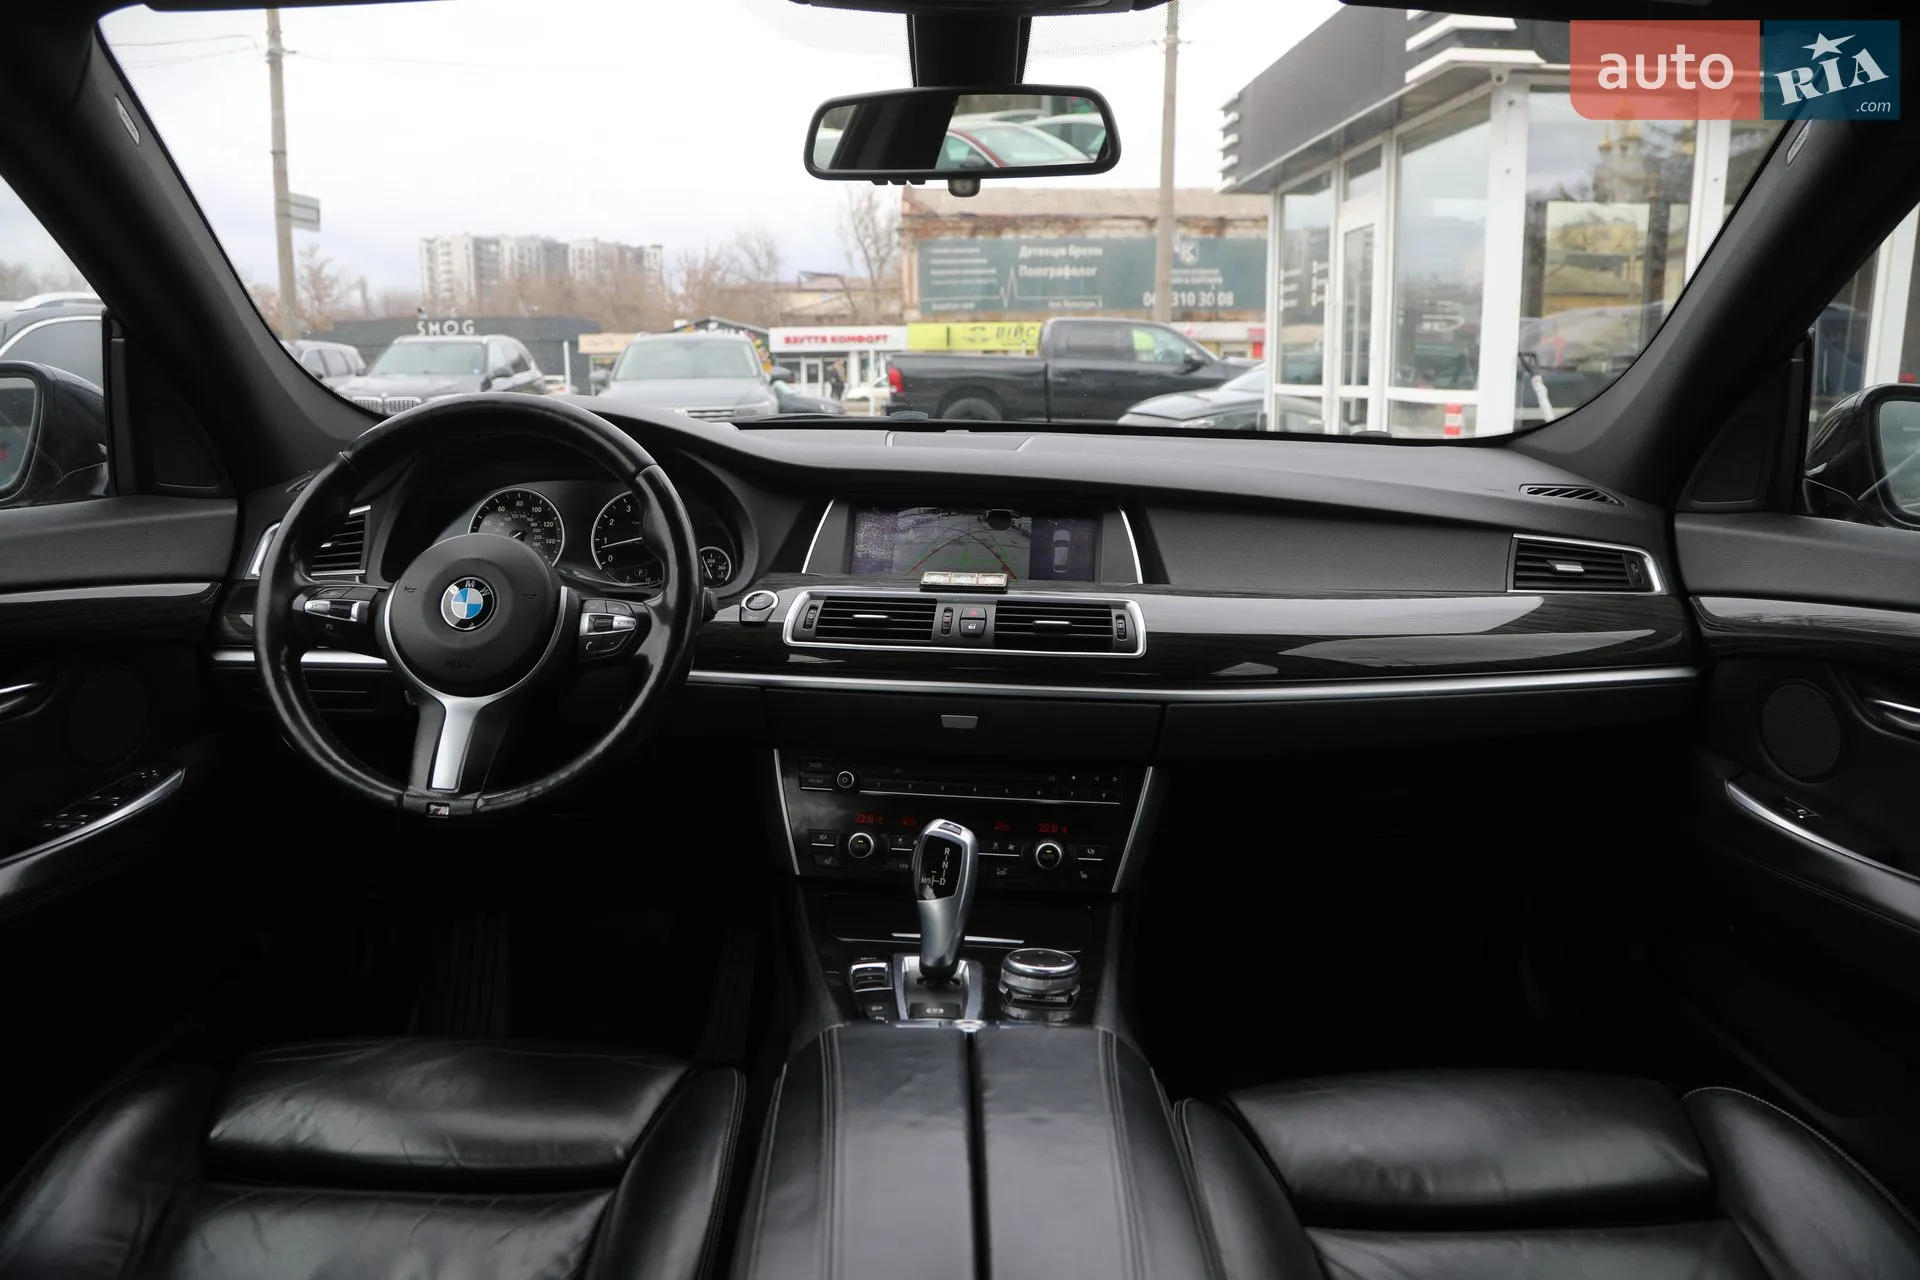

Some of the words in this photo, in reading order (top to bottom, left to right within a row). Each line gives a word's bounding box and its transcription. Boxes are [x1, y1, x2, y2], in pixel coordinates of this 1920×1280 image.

[1198, 291, 1216, 307] 30
[416, 319, 475, 336] SMOG
[830, 334, 889, 345] КОМФОРТ
[609, 518, 615, 526] 2
[449, 580, 491, 597] BMW
[944, 847, 951, 856] R
[942, 861, 949, 869] N
[939, 877, 946, 886] D
